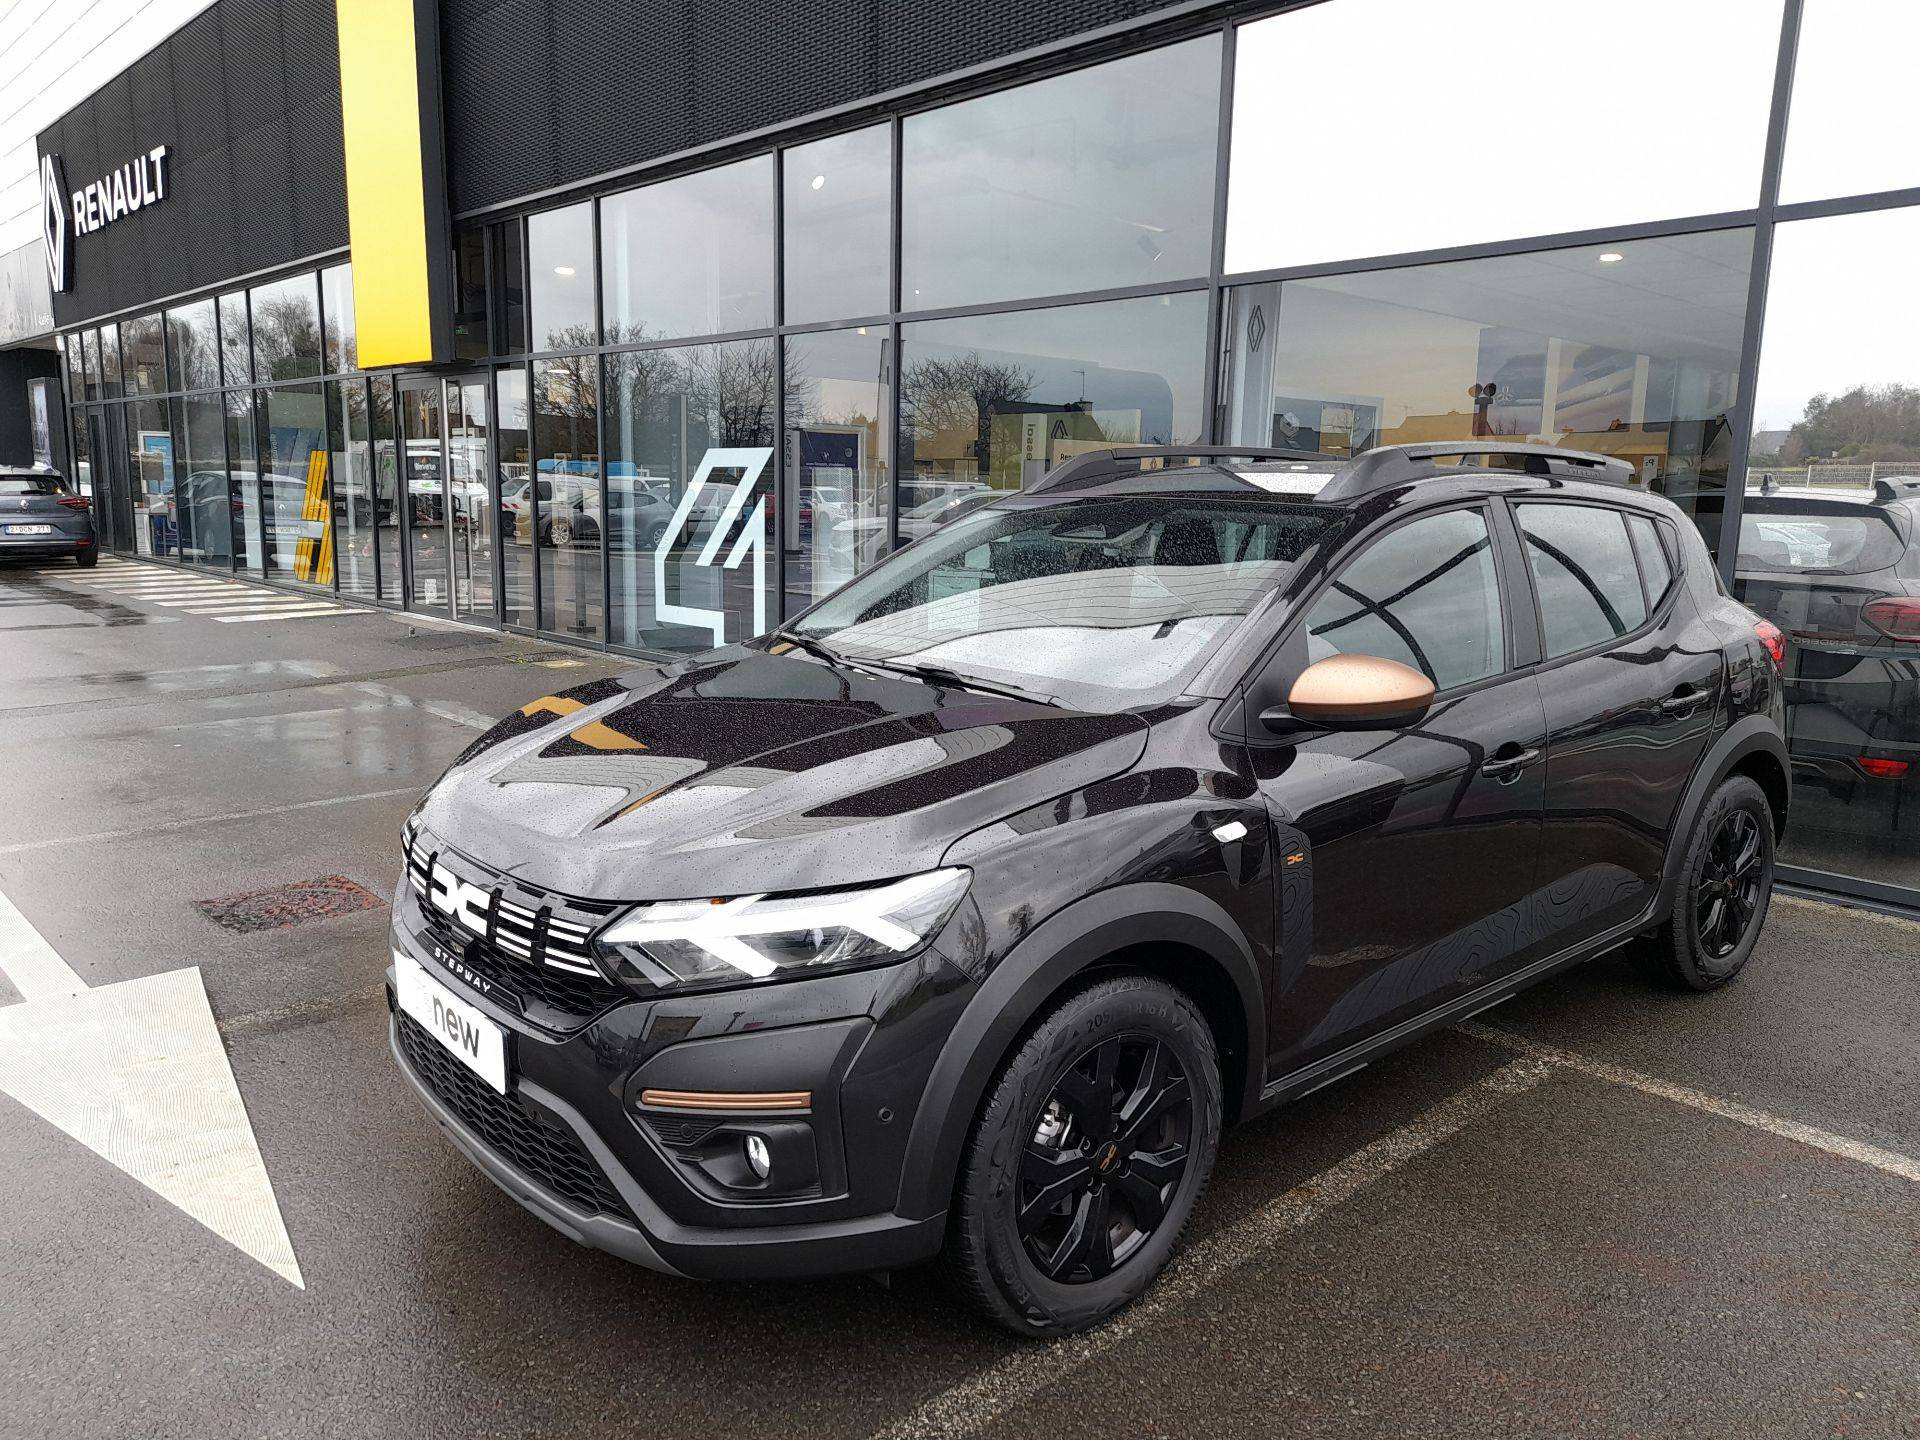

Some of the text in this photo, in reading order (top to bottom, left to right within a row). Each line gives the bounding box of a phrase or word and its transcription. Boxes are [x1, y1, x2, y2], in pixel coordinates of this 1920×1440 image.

[72, 145, 166, 237] RENAULT
[434, 947, 491, 993] STEPWAY
[433, 995, 480, 1058] new
